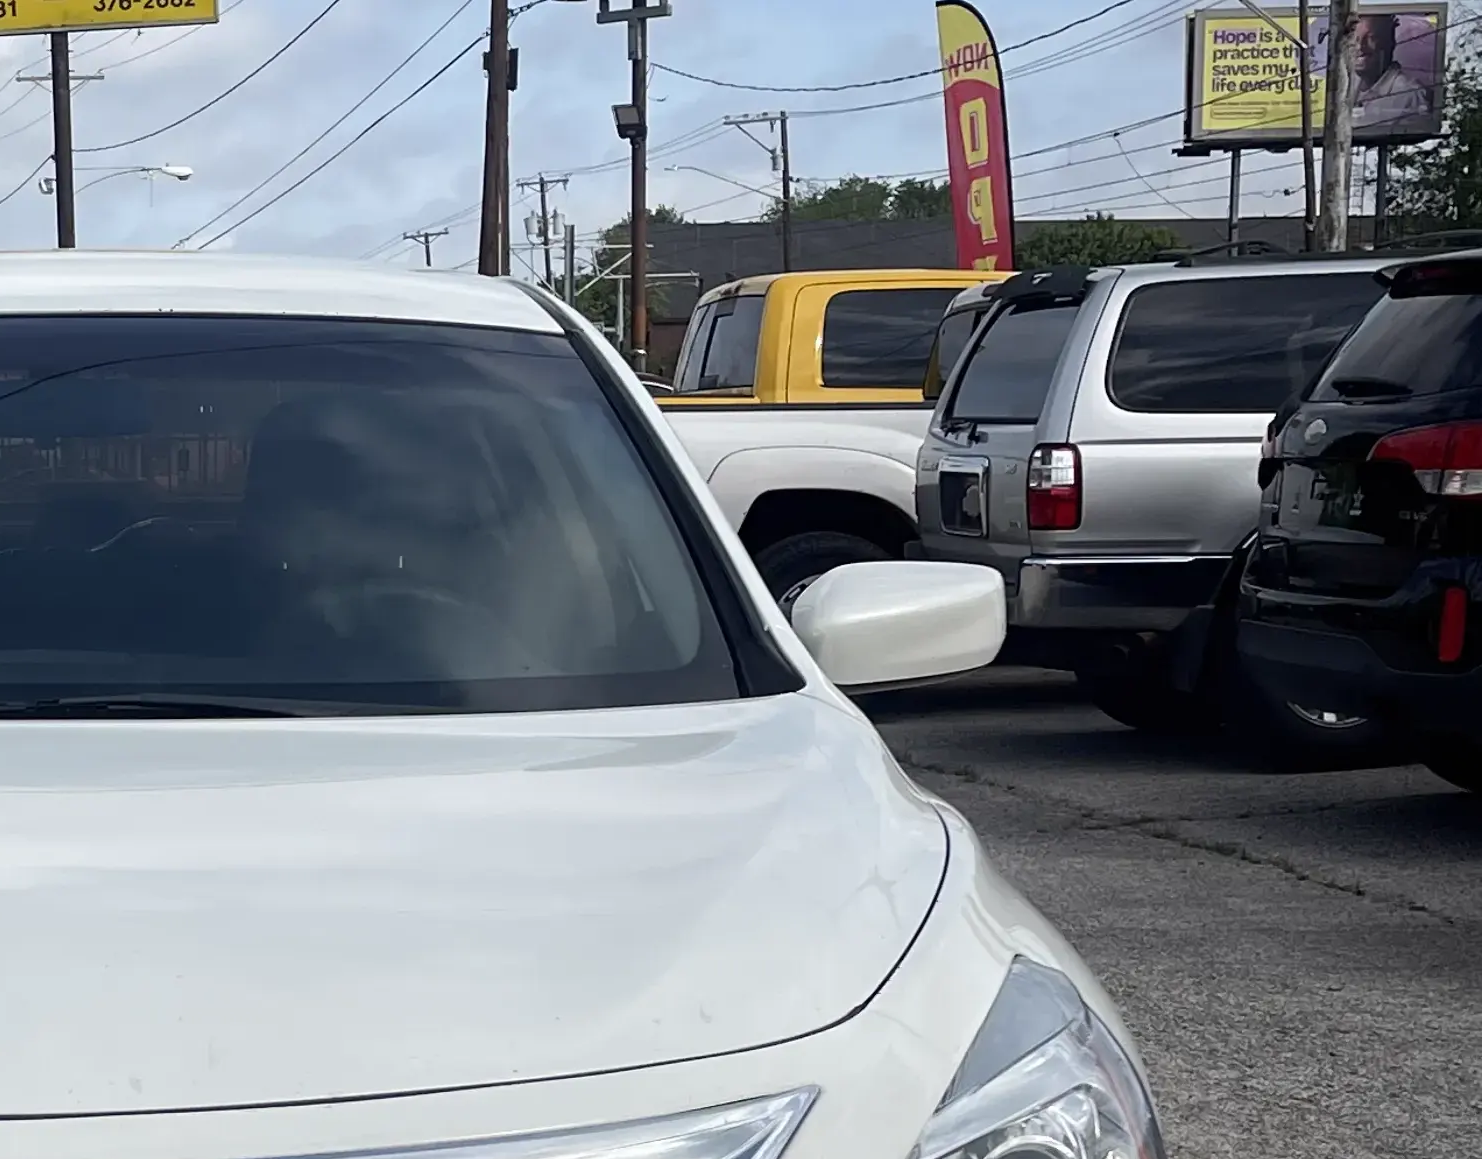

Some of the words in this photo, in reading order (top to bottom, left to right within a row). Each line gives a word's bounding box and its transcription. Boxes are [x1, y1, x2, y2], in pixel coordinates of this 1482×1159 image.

[1259, 27, 1273, 42] is
[1275, 30, 1286, 43] a
[1212, 44, 1280, 63] practice
[1282, 44, 1316, 58] tht
[1212, 63, 1259, 77] saves
[1262, 63, 1290, 78] my
[1212, 76, 1237, 93] life
[1239, 79, 1286, 95] every
[1288, 74, 1319, 93] dy
